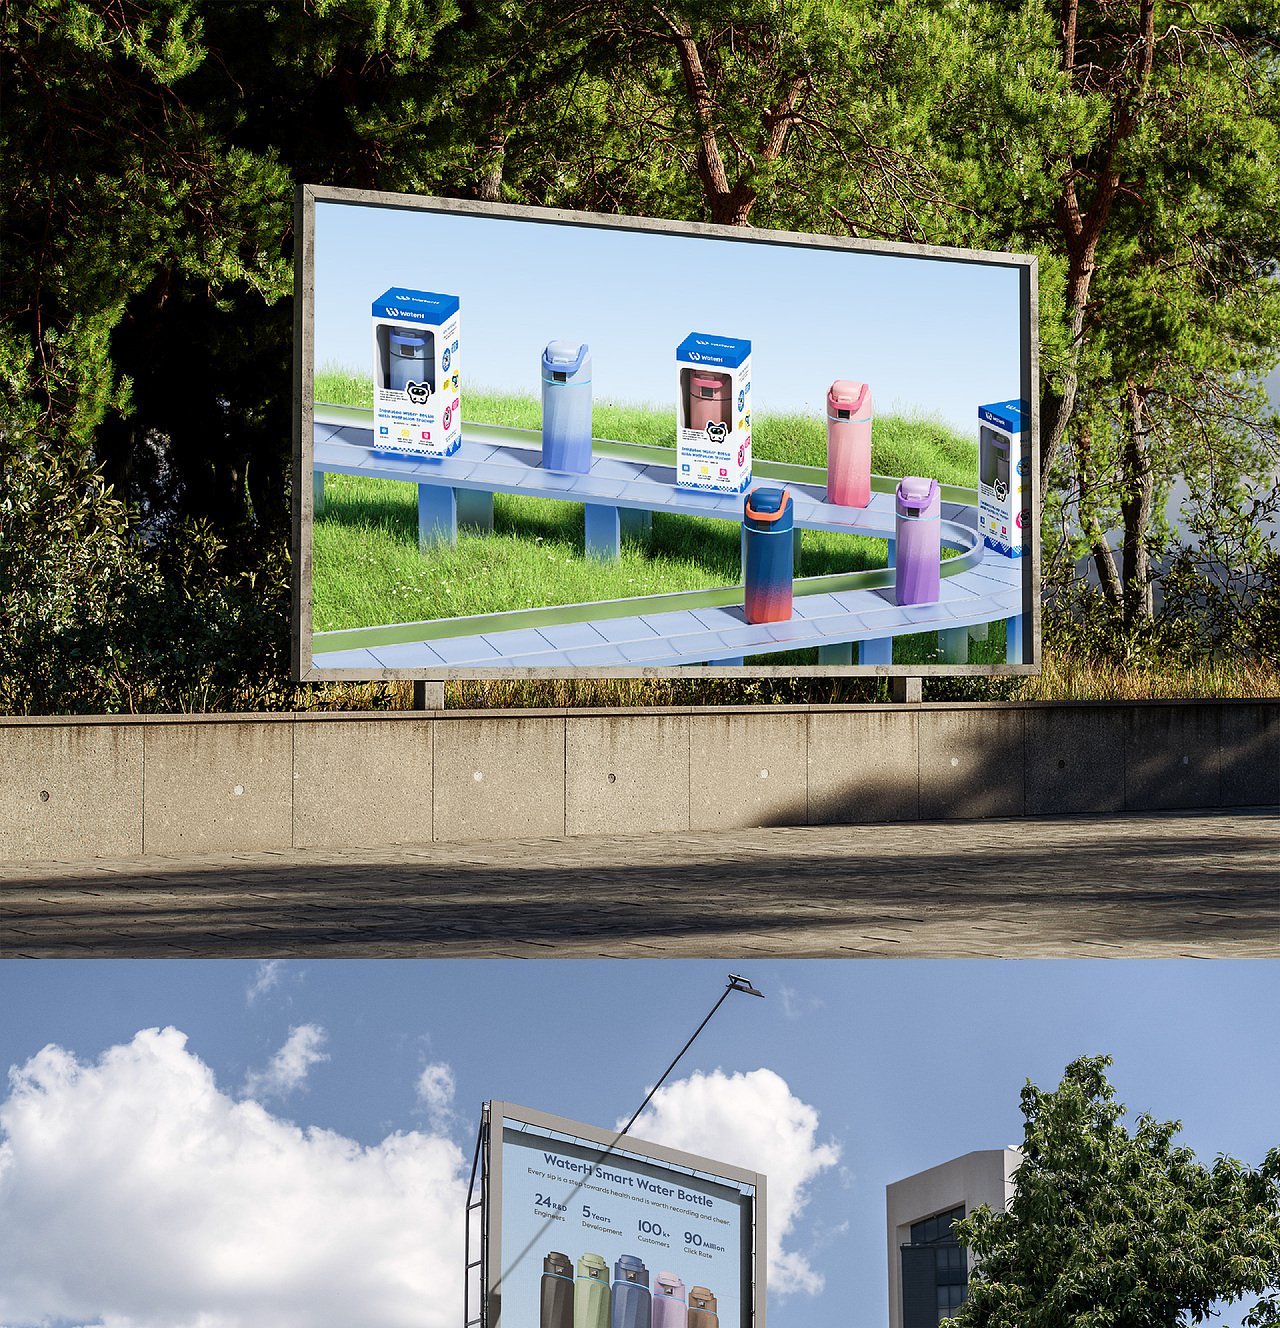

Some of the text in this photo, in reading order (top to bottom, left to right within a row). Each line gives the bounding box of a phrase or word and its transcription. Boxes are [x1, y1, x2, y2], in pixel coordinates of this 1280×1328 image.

[544, 1153, 714, 1208] WaterH Smart Water Bottle
[528, 1168, 545, 1178] Every
[569, 1179, 582, 1187] step
[584, 1183, 609, 1194] towards
[610, 1189, 630, 1200] health
[651, 1200, 668, 1210] worth
[670, 1205, 699, 1218] recording
[713, 1216, 731, 1226] cheer.
[534, 1193, 567, 1212] 24 R&D
[534, 1208, 565, 1221] Engineers
[582, 1205, 611, 1223] 5 Years
[582, 1220, 622, 1236] Development
[638, 1220, 662, 1236] 100
[638, 1235, 670, 1248] Customers
[684, 1232, 725, 1252] 90 Million
[684, 1247, 697, 1256] Click
